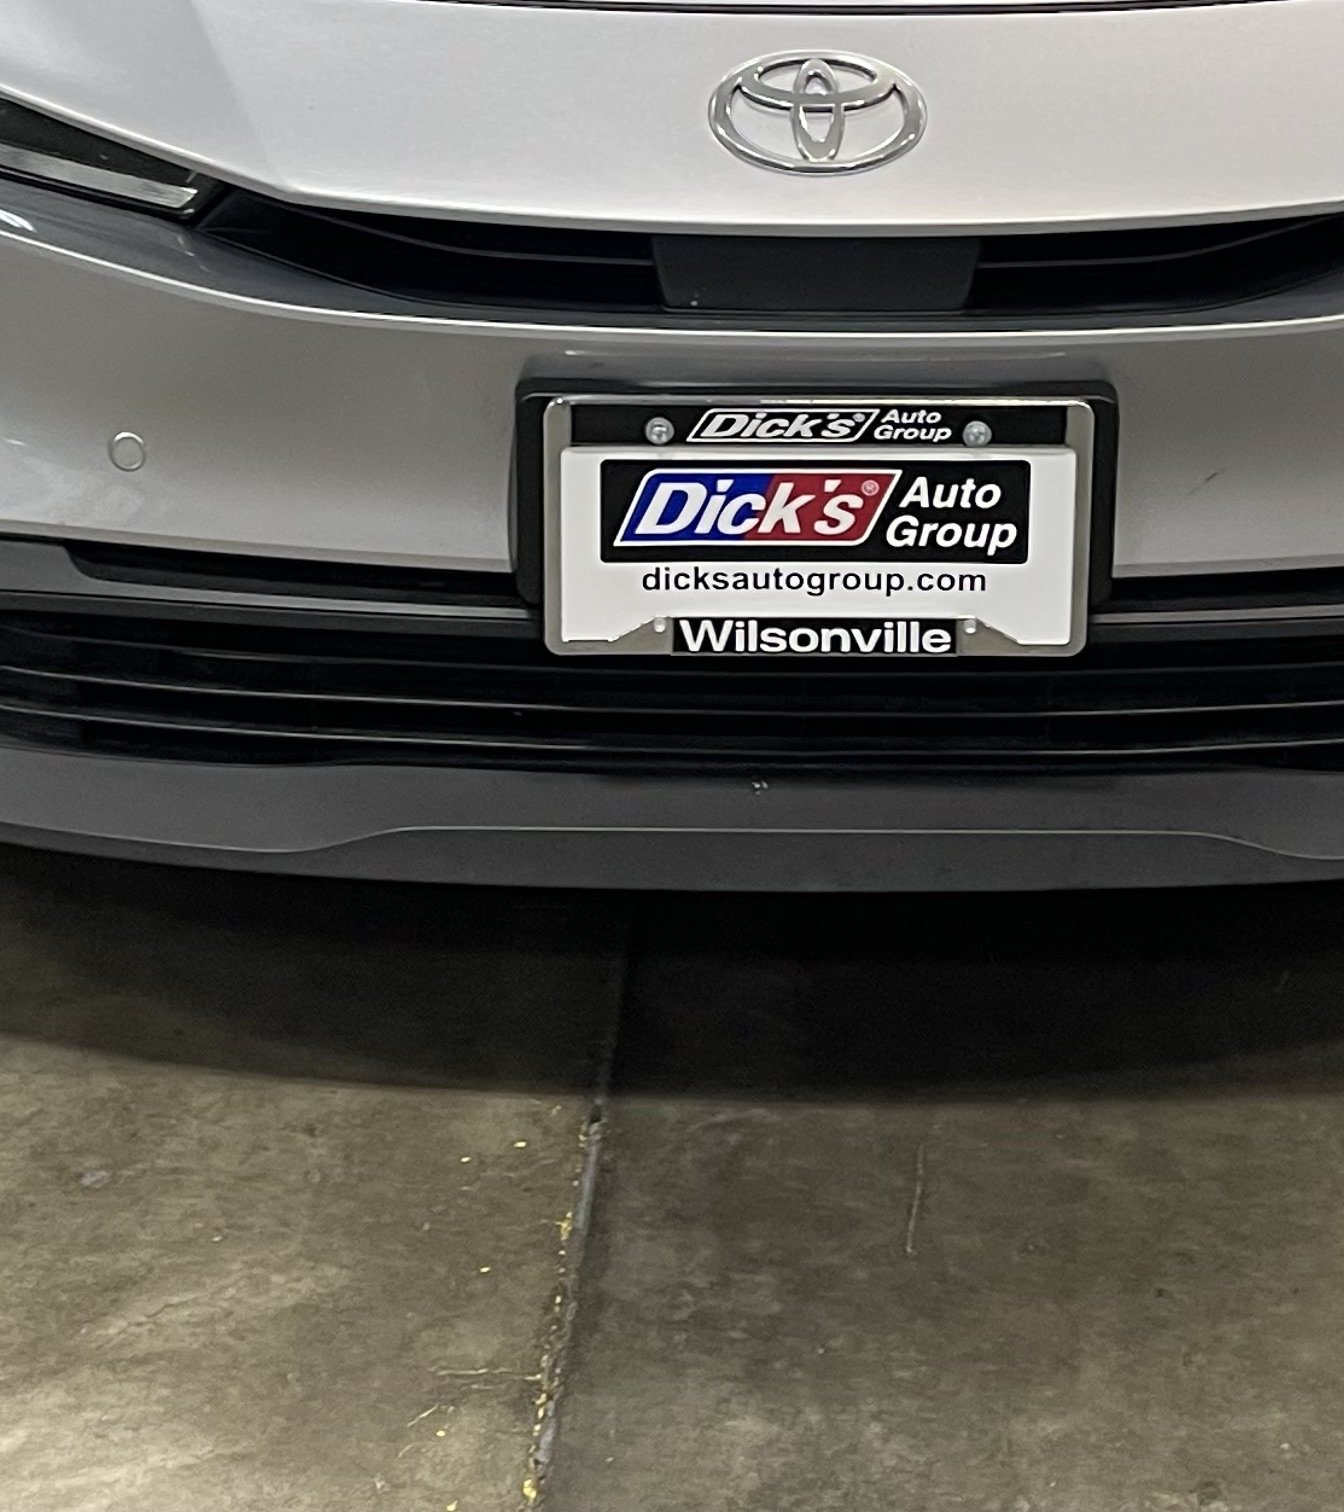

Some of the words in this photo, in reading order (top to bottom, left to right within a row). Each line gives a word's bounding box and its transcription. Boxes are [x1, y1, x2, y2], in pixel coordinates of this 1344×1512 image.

[702, 411, 857, 440] Dick's
[880, 408, 942, 425] Auto
[873, 425, 952, 443] Group
[634, 479, 864, 537] Dick's
[899, 476, 1002, 510] Auto
[885, 515, 1018, 556] Group
[641, 566, 987, 597] dicksautogroup.com
[678, 618, 952, 654] Wilsonville
